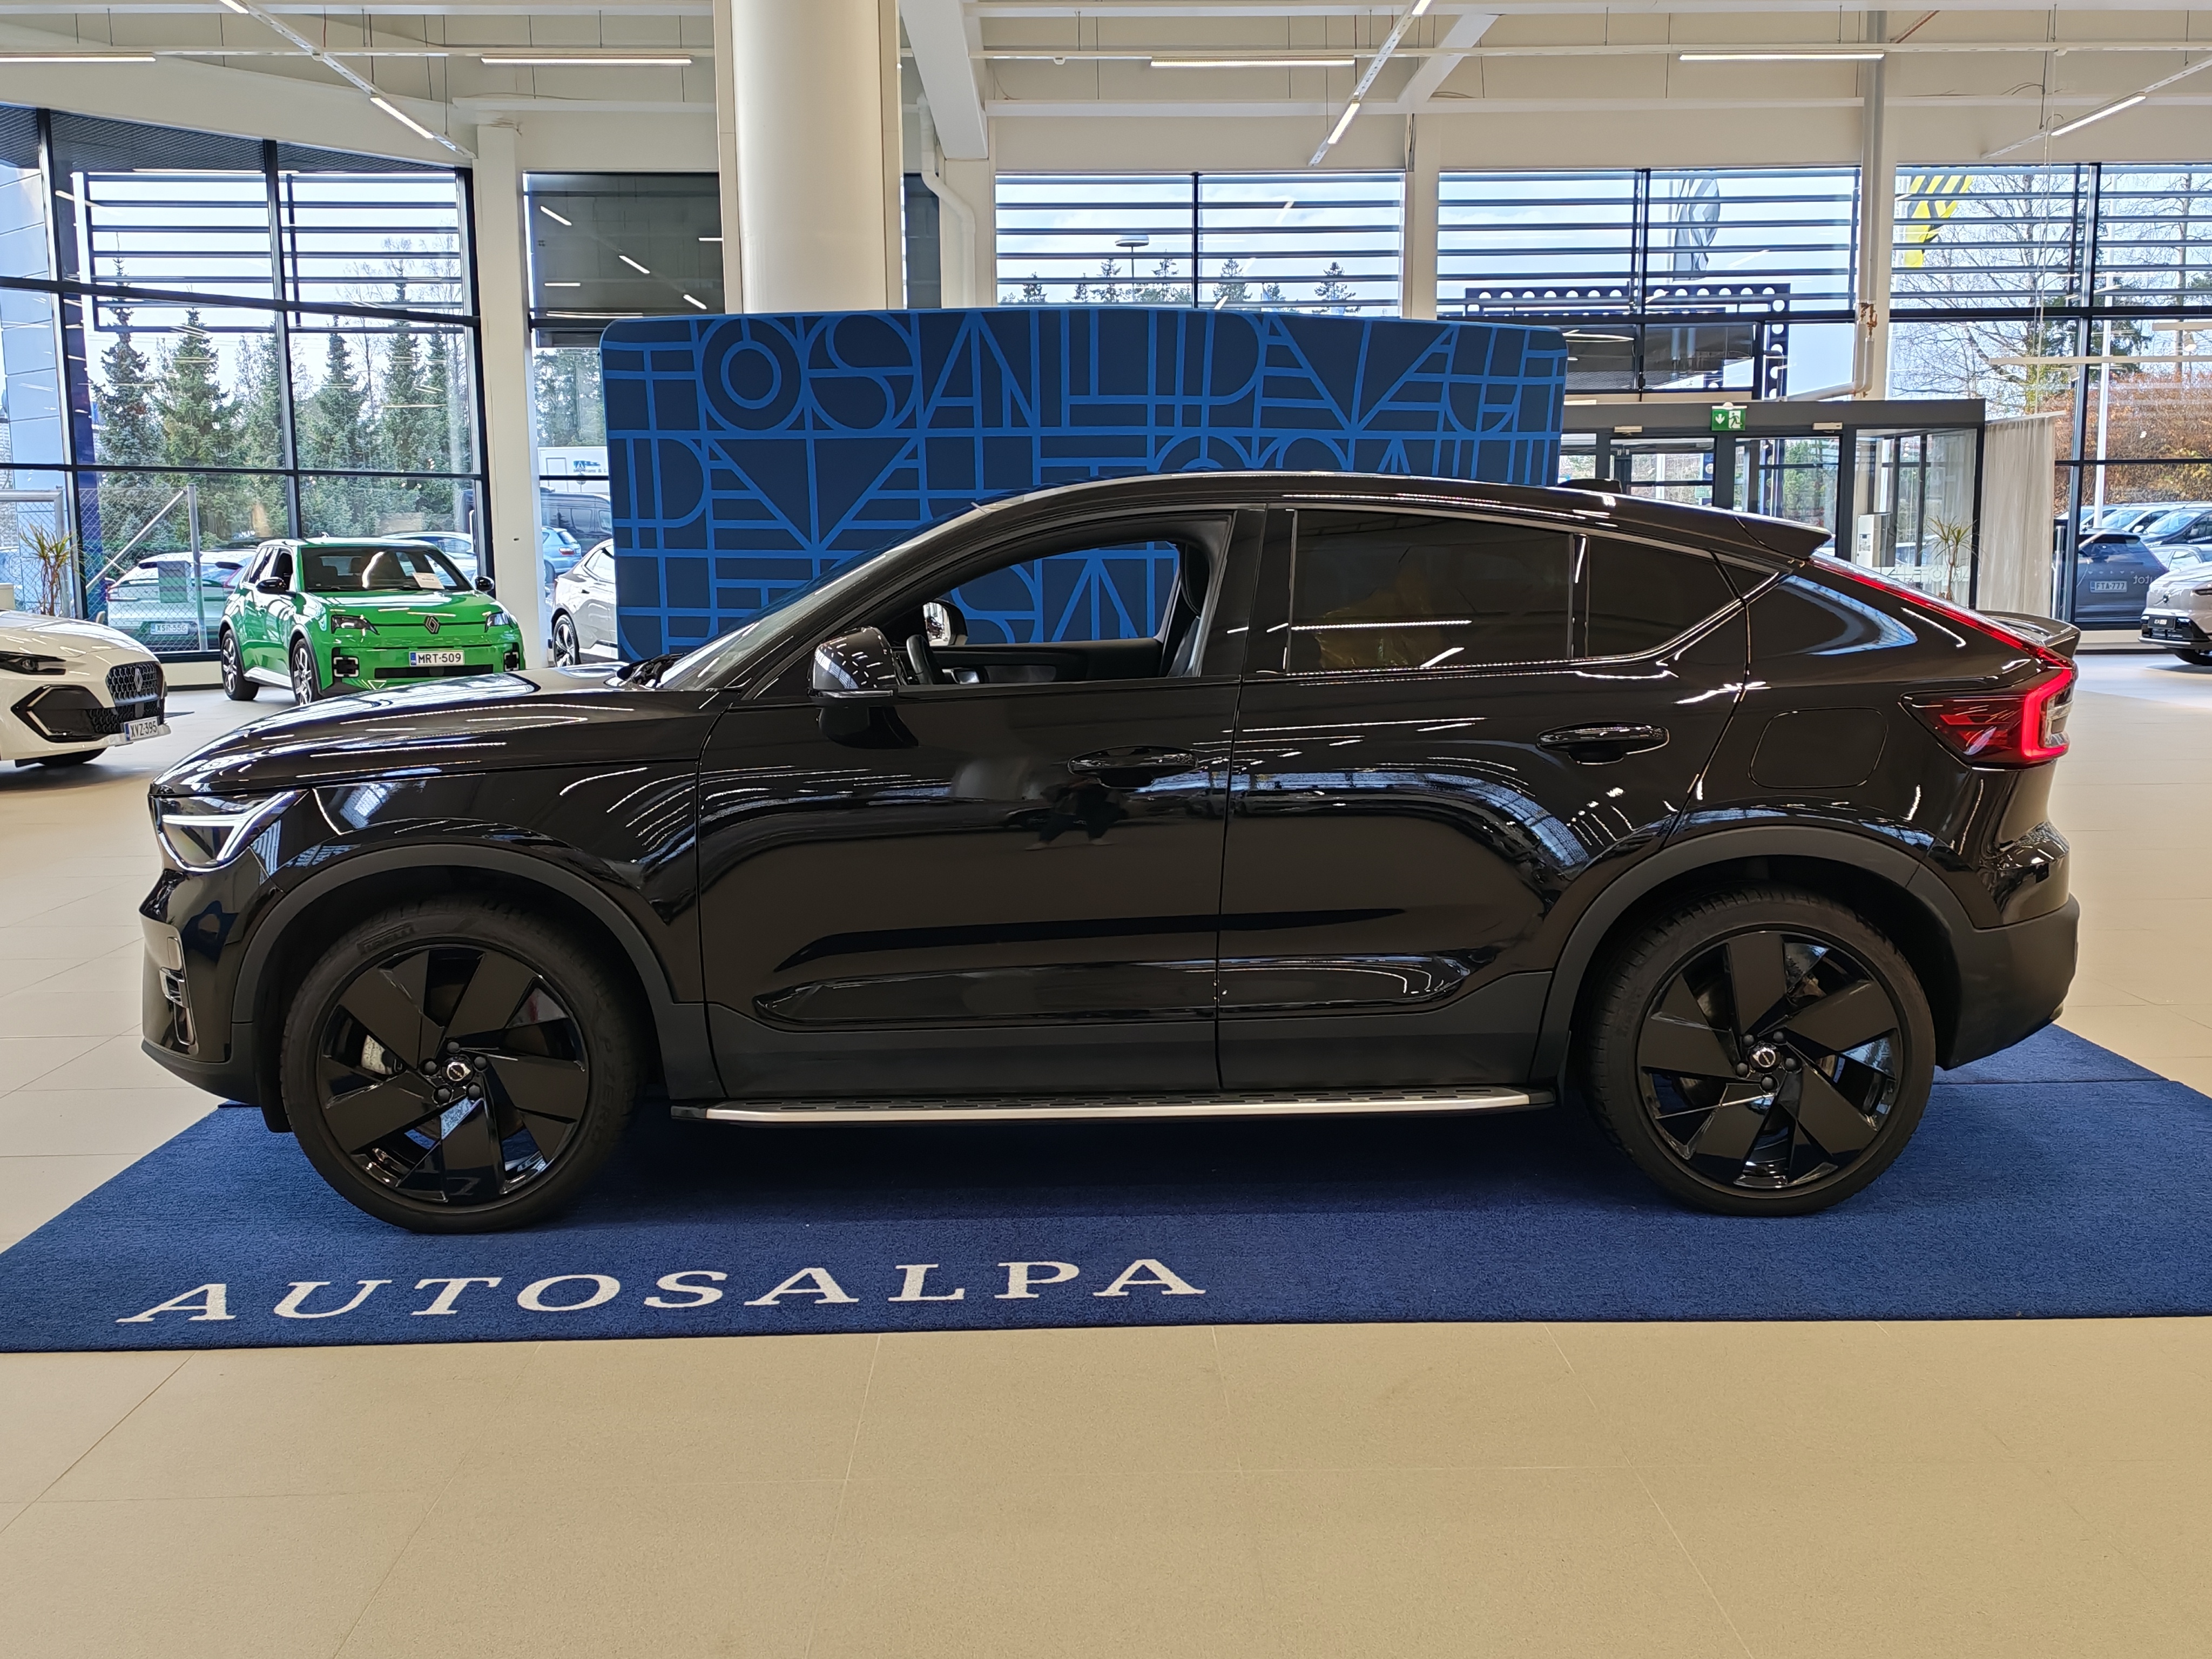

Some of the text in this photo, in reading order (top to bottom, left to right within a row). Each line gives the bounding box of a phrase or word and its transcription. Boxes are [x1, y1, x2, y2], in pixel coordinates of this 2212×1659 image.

[417, 653, 461, 664] MRT-509
[130, 720, 157, 738] XVZ-395
[116, 1259, 1206, 1323] AUTOSALPA
